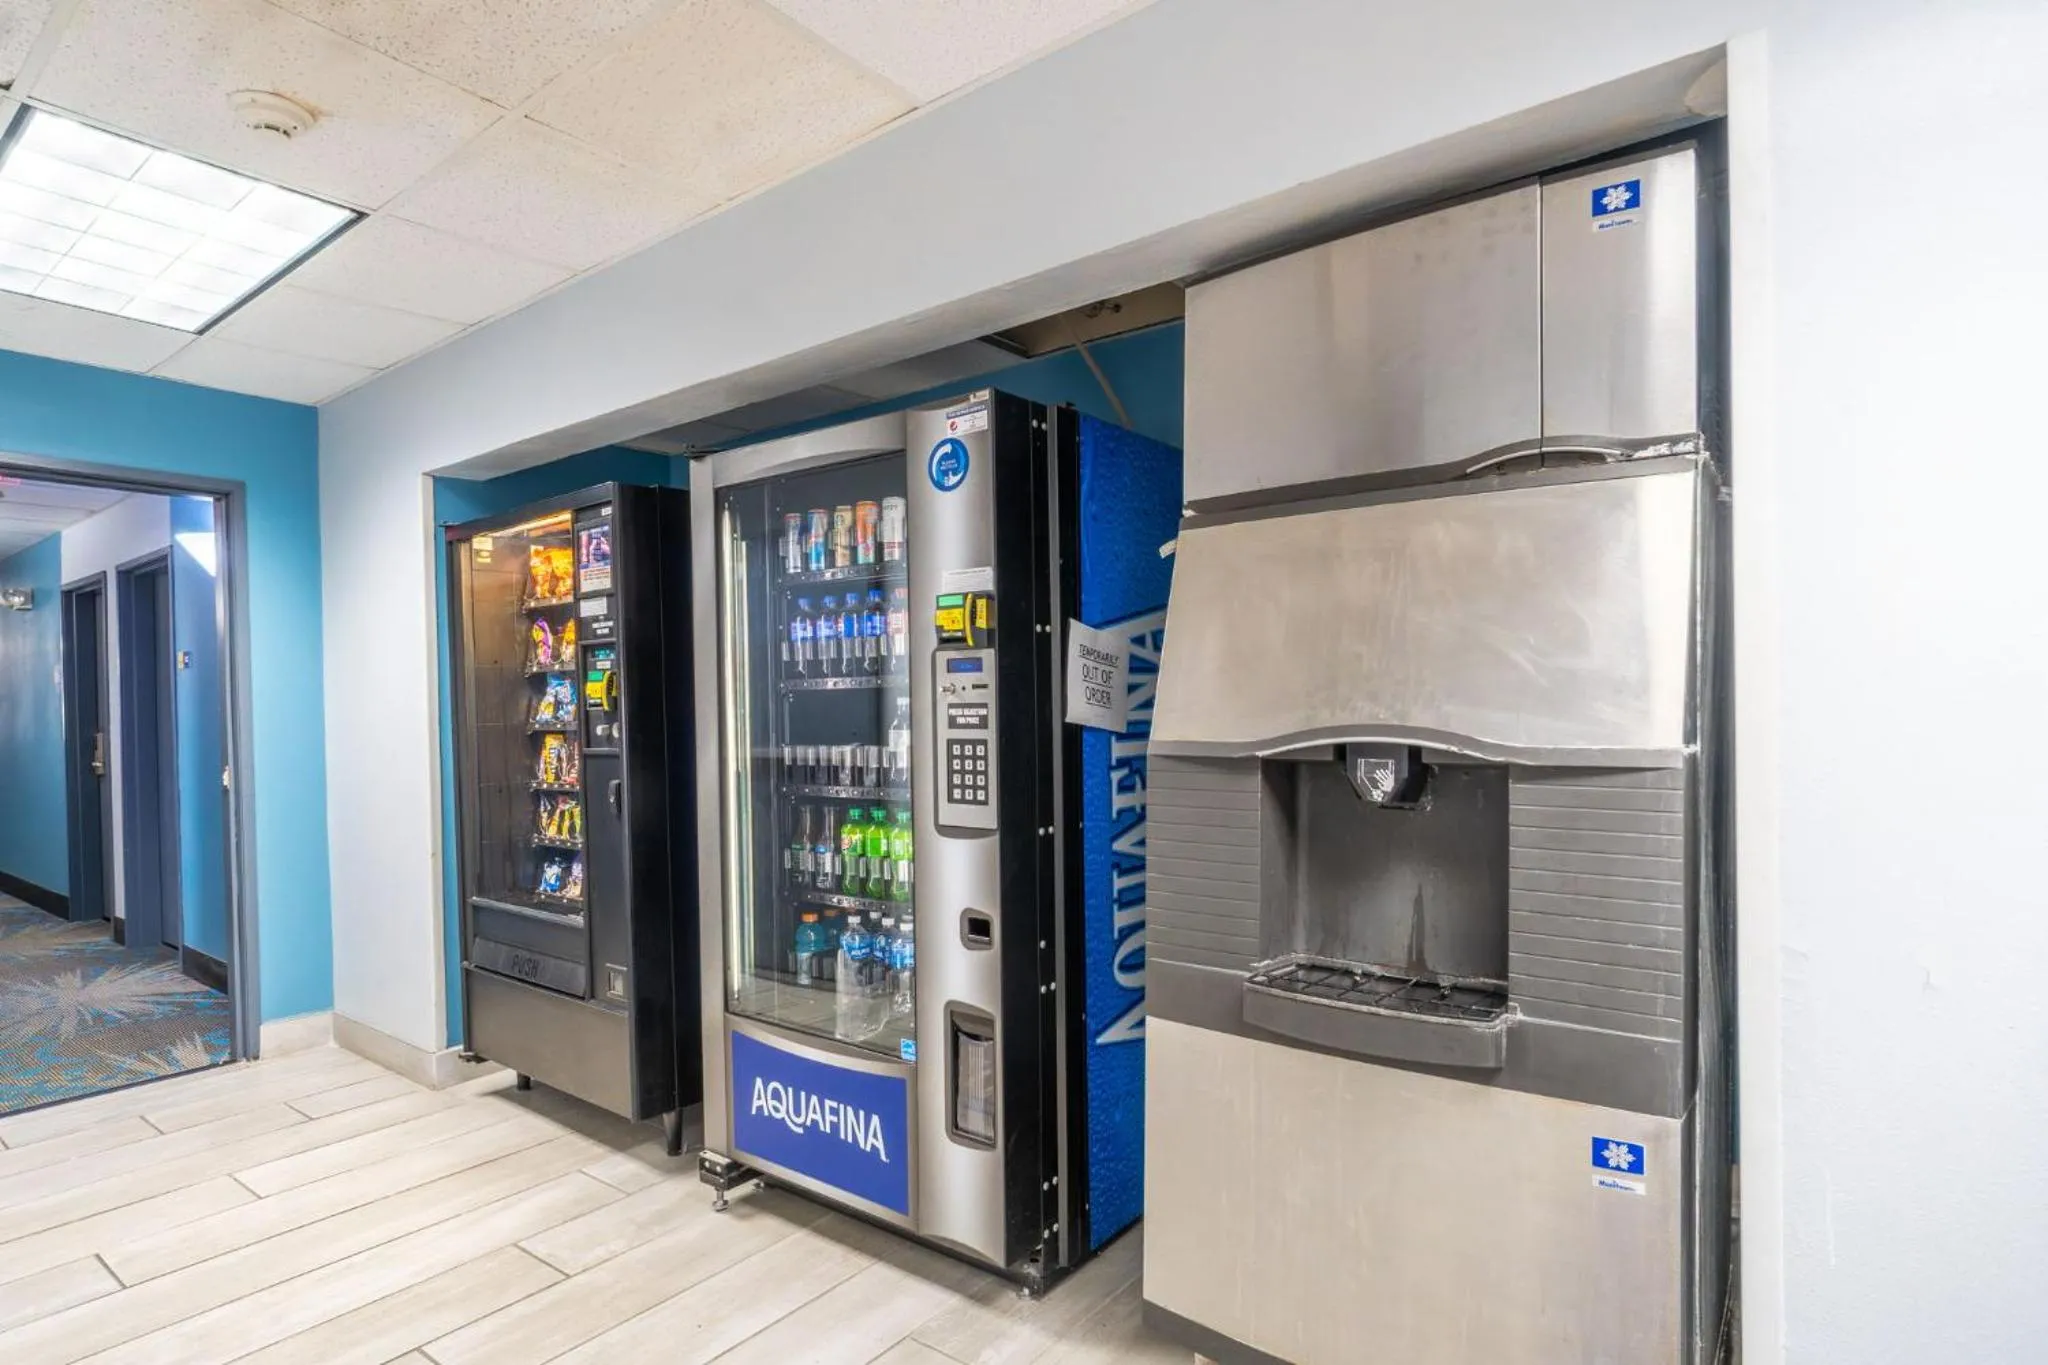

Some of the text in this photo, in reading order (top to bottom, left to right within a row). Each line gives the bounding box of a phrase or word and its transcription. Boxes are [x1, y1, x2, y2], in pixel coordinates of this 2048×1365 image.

[1082, 663, 1114, 685] OUT OF
[1085, 686, 1112, 705] ORDER
[511, 953, 539, 978] PUSH
[752, 1076, 890, 1164] AQUAFINA
